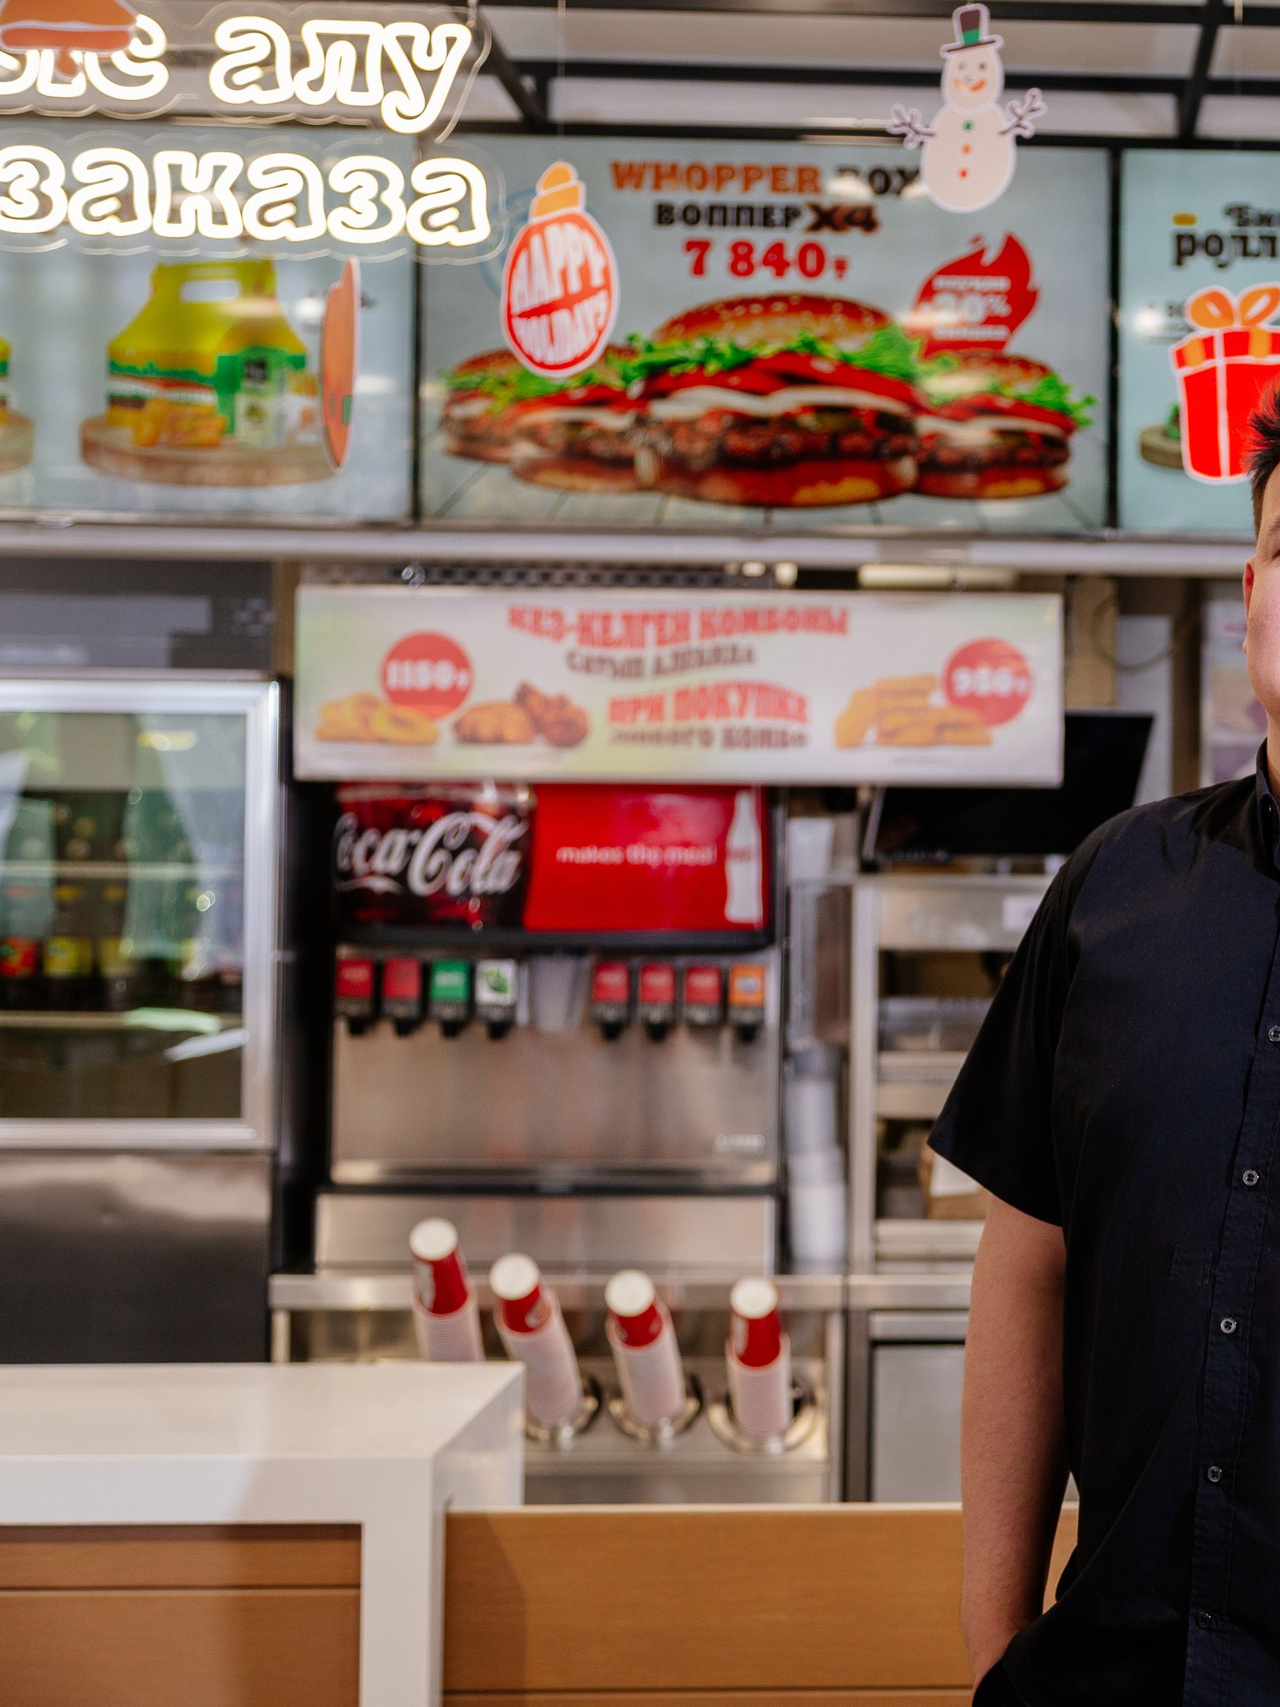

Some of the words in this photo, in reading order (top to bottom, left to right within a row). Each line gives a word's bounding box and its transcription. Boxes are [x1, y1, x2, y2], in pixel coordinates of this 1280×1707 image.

[208, 15, 473, 134] алу
[0, 144, 492, 247] заказа
[610, 162, 822, 194] WHOPPER
[654, 203, 803, 229] ВОППЕР
[509, 222, 605, 314] HAPPY
[685, 240, 713, 277] 7
[1174, 231, 1280, 269] ролл
